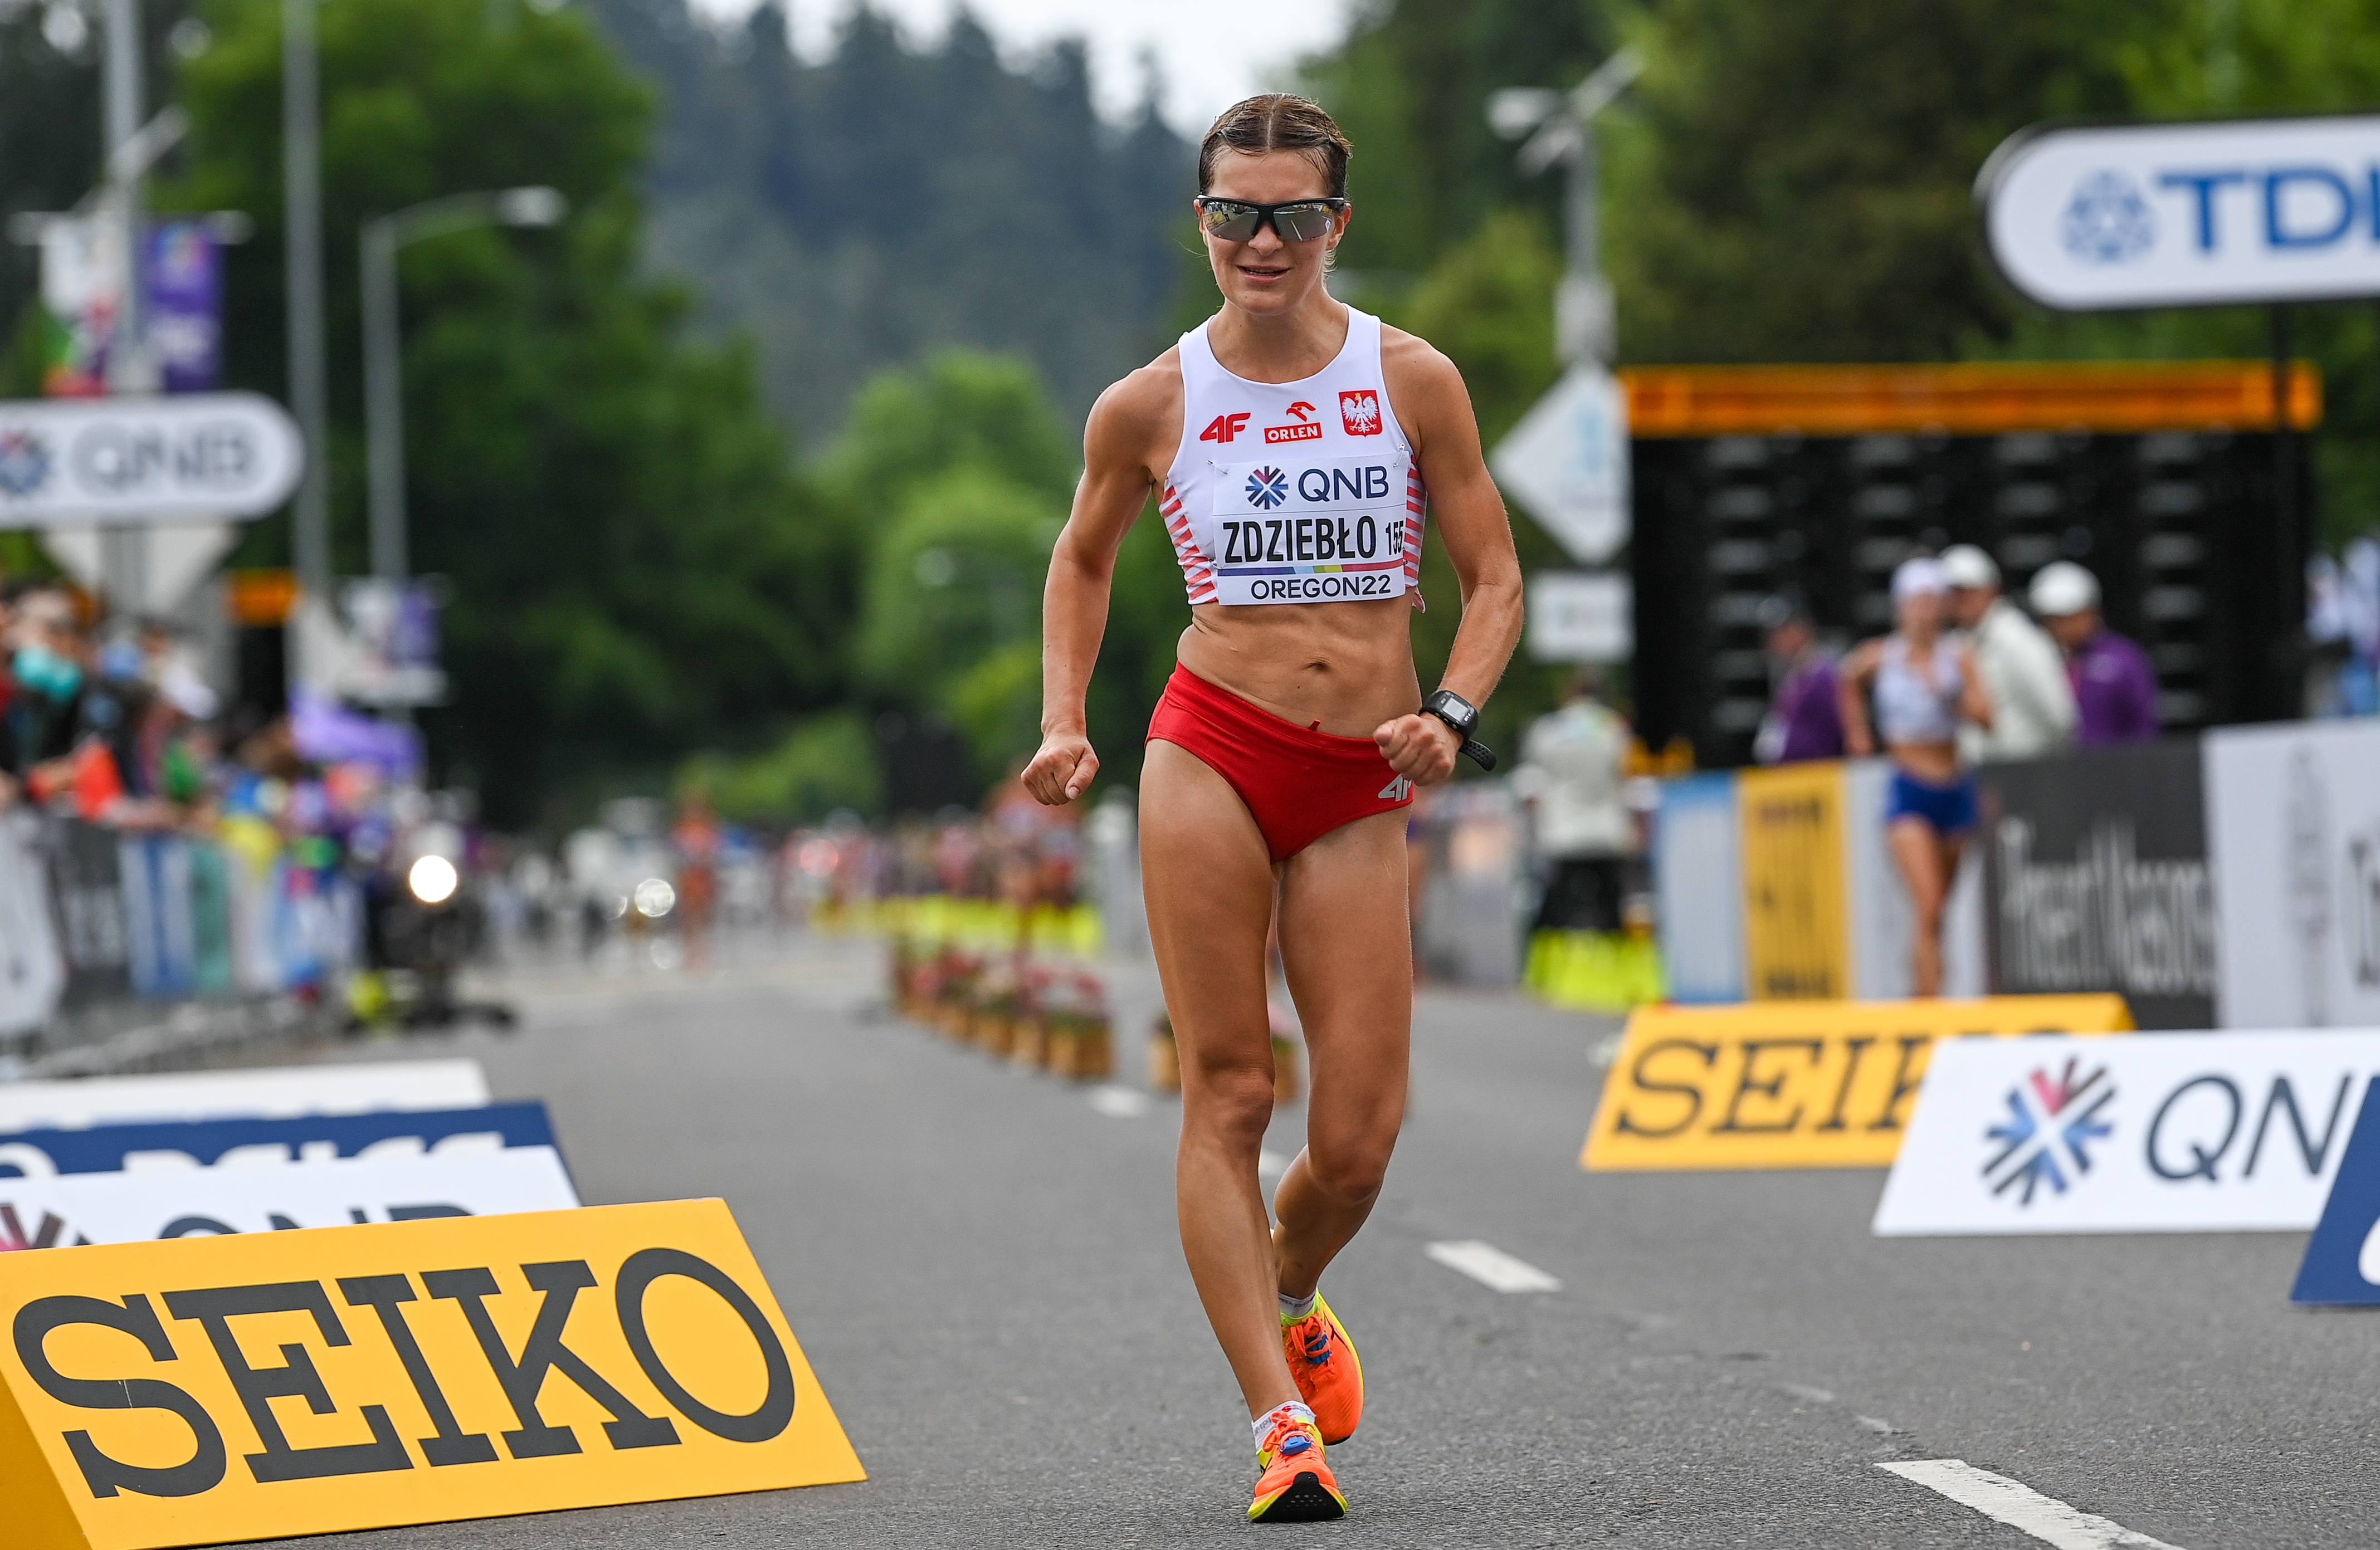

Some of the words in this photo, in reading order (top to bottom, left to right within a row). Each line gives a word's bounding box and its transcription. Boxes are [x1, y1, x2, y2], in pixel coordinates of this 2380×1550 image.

[2155, 166, 2380, 255] TD
[1199, 412, 1251, 443] 4F
[1267, 425, 1319, 442] ORLEN
[1298, 466, 1389, 502] QNB
[1222, 515, 1377, 564] ZDZIEBŁO
[1251, 574, 1391, 600] OREGON22
[2146, 1074, 2352, 1182] QN
[12, 1248, 795, 1499] SEIKO
